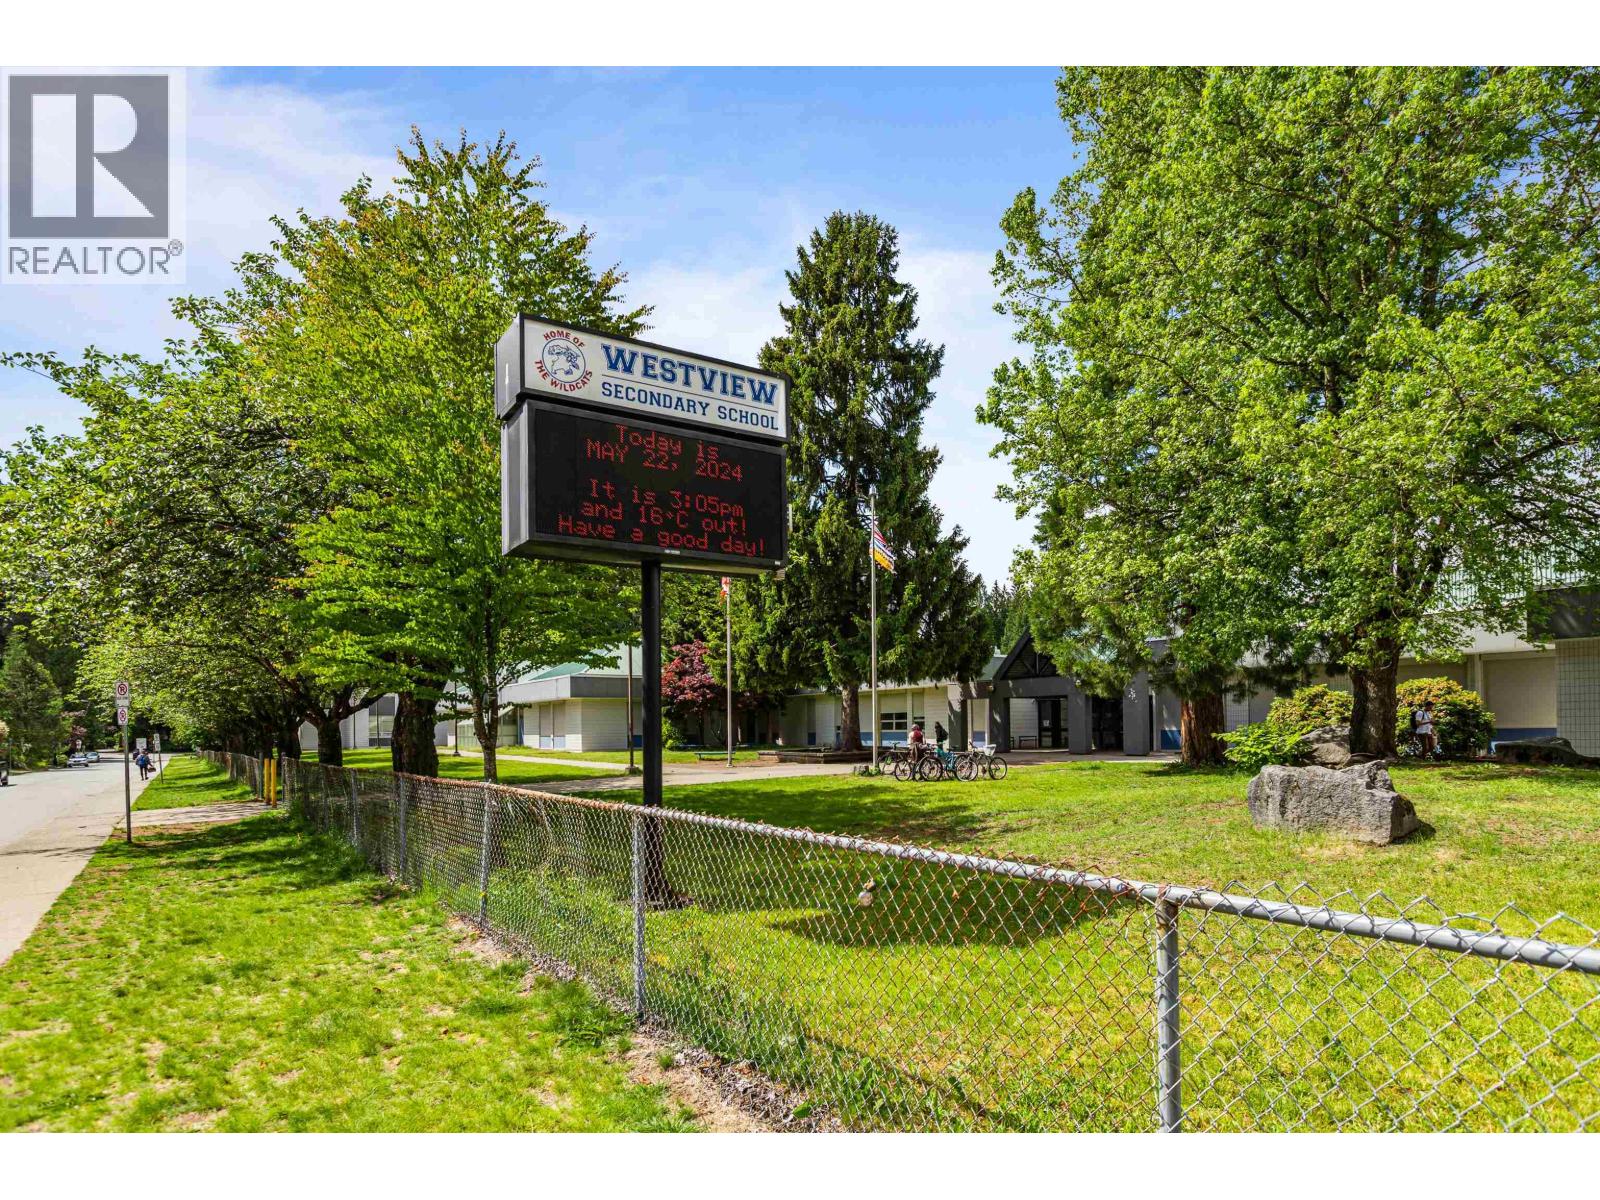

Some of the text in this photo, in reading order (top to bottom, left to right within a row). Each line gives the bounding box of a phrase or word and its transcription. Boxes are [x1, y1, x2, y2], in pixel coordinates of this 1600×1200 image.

[543, 330, 585, 348] HOME OF
[535, 360, 593, 392] THE WILDCATS
[600, 342, 778, 406] WESTVIEW
[601, 381, 779, 431] SECONDARY SCHOOL
[585, 438, 743, 481] MAY 22, 2024
[616, 424, 719, 460] Today is
[590, 478, 744, 517] It is 3:05pm
[558, 511, 765, 557] Have a good day!
[580, 501, 623, 521] and
[701, 517, 747, 536] out!
